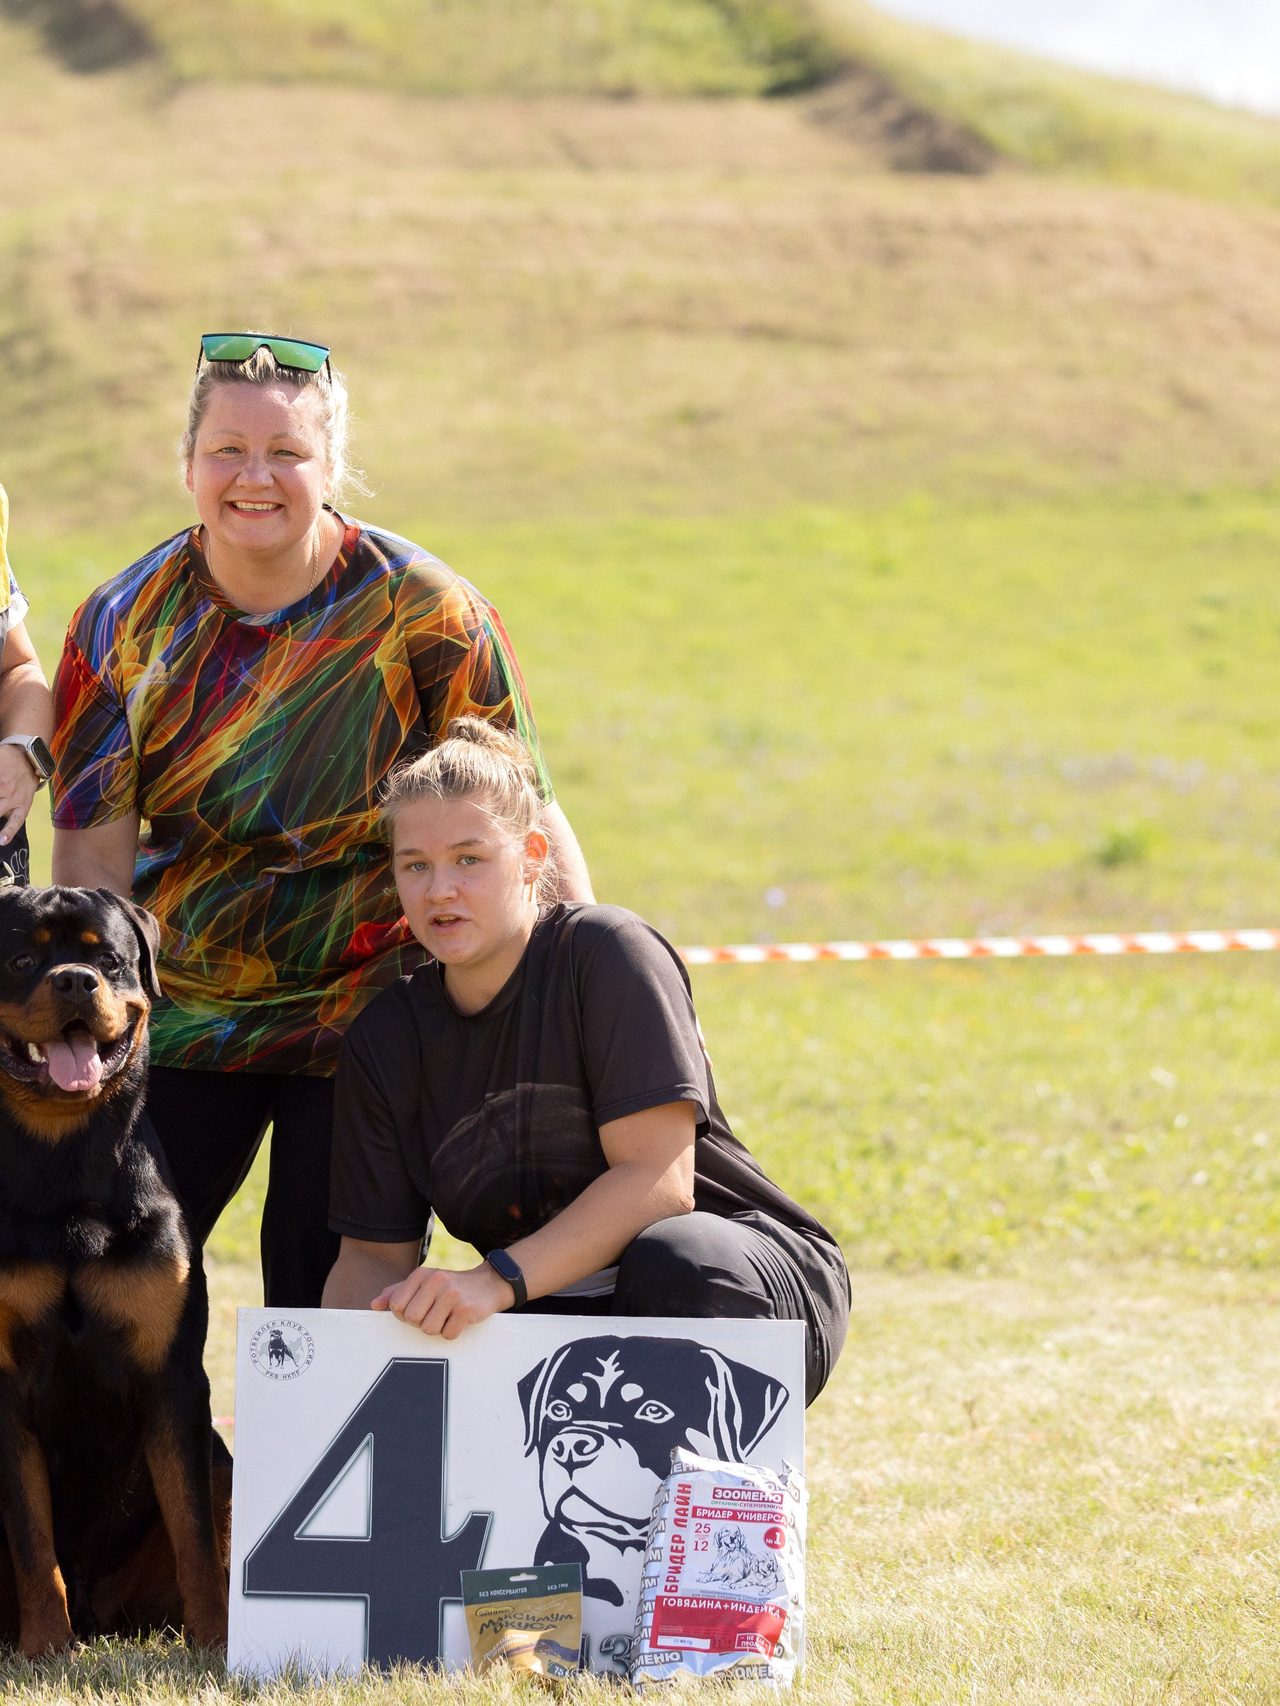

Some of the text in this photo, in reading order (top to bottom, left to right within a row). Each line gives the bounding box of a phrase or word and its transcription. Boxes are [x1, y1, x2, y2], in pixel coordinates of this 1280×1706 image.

[251, 1321, 315, 1365] РОТВЕЙЛЕР КЛУБ РОССИИ
[714, 1488, 782, 1503] ЗООМЕНЮ
[673, 1483, 692, 1528] ЛАЙН
[243, 1356, 495, 1676] 4
[696, 1508, 733, 1518] БРИДЕР
[694, 1522, 711, 1534] 25
[693, 1540, 709, 1551] 12
[664, 1534, 686, 1593] БРИДЕР
[490, 1587, 528, 1596] КОНСЕРВАНТОВ
[554, 1665, 564, 1676] 75
